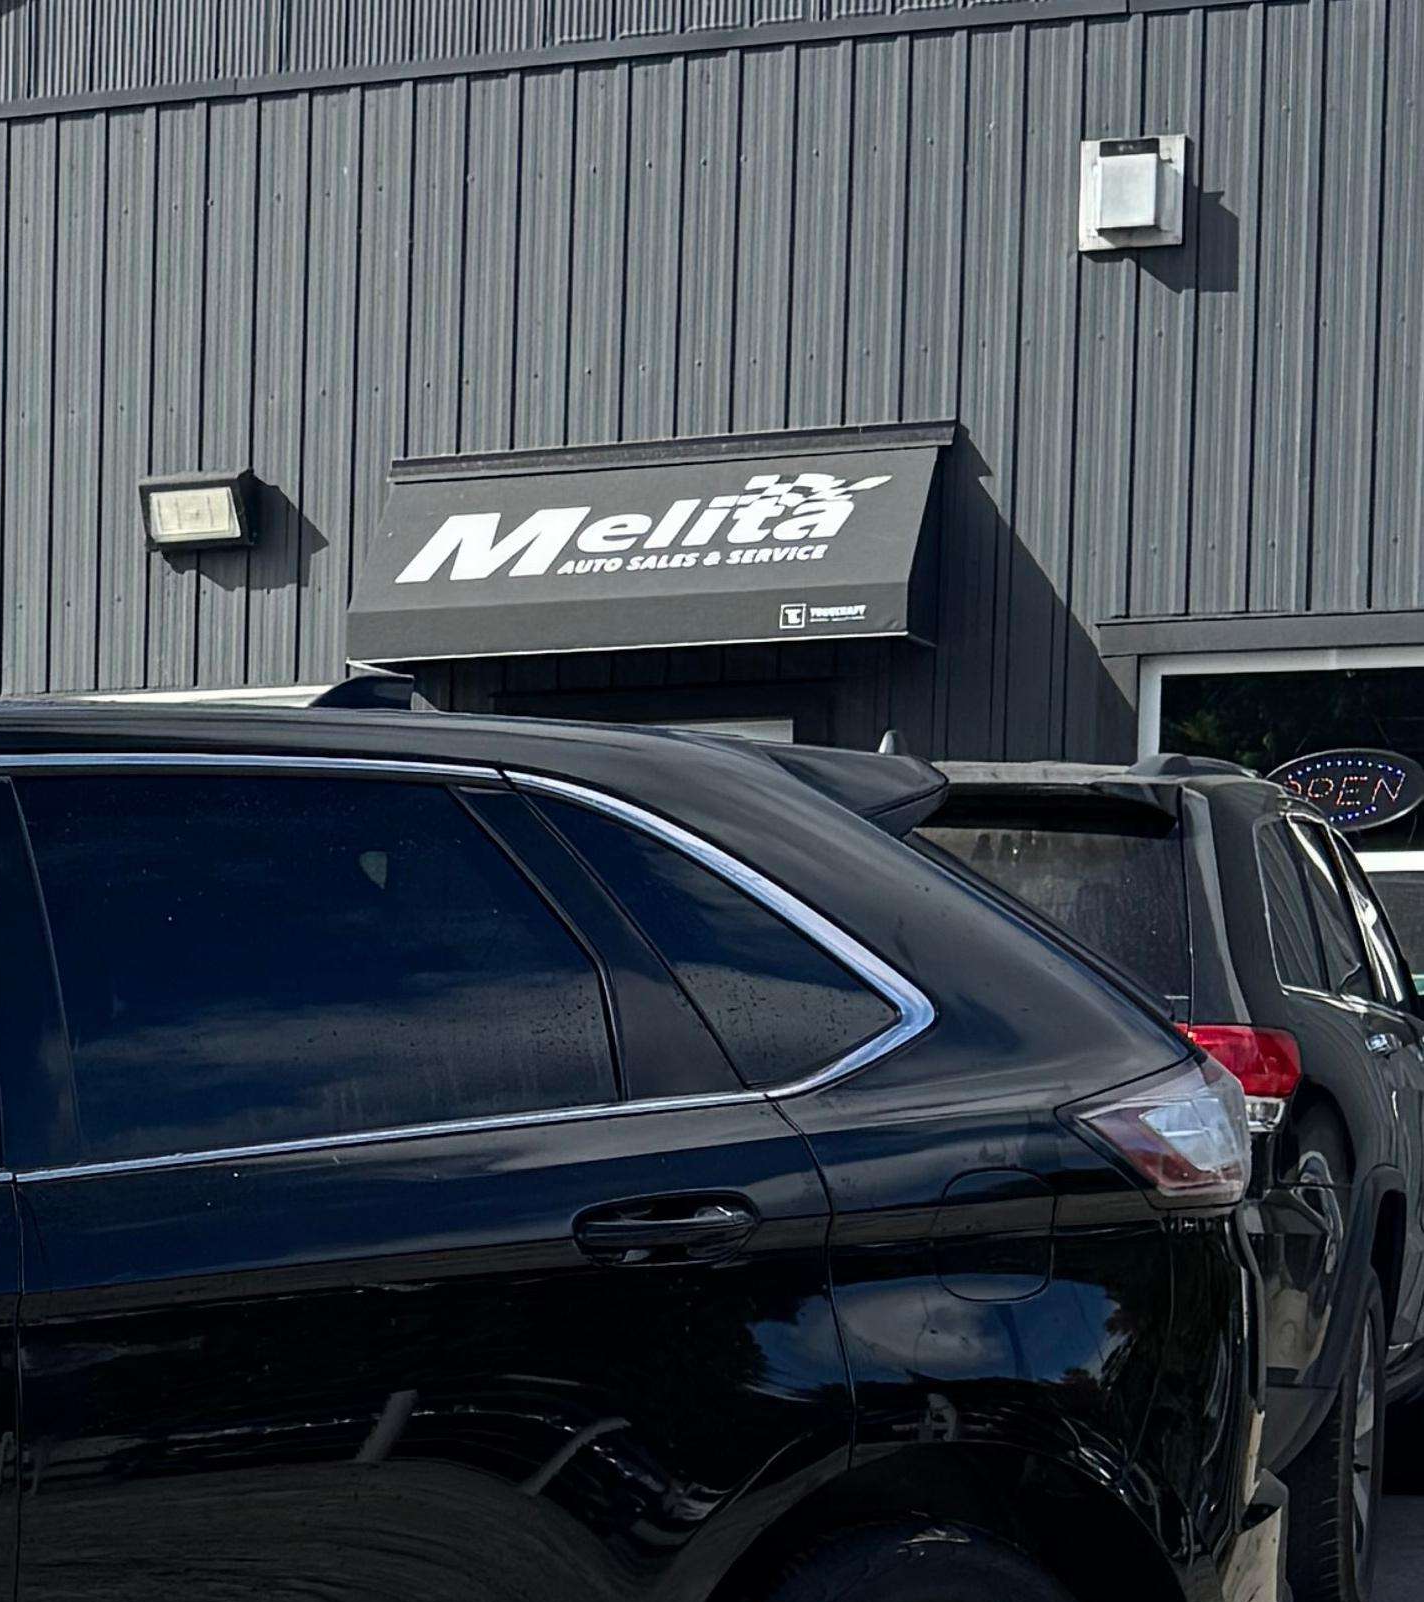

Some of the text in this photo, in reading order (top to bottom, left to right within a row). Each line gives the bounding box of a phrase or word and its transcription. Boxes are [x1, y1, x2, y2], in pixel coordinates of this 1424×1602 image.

[394, 490, 856, 584] Melita
[556, 544, 829, 575] AUTO SALES & SERVICE
